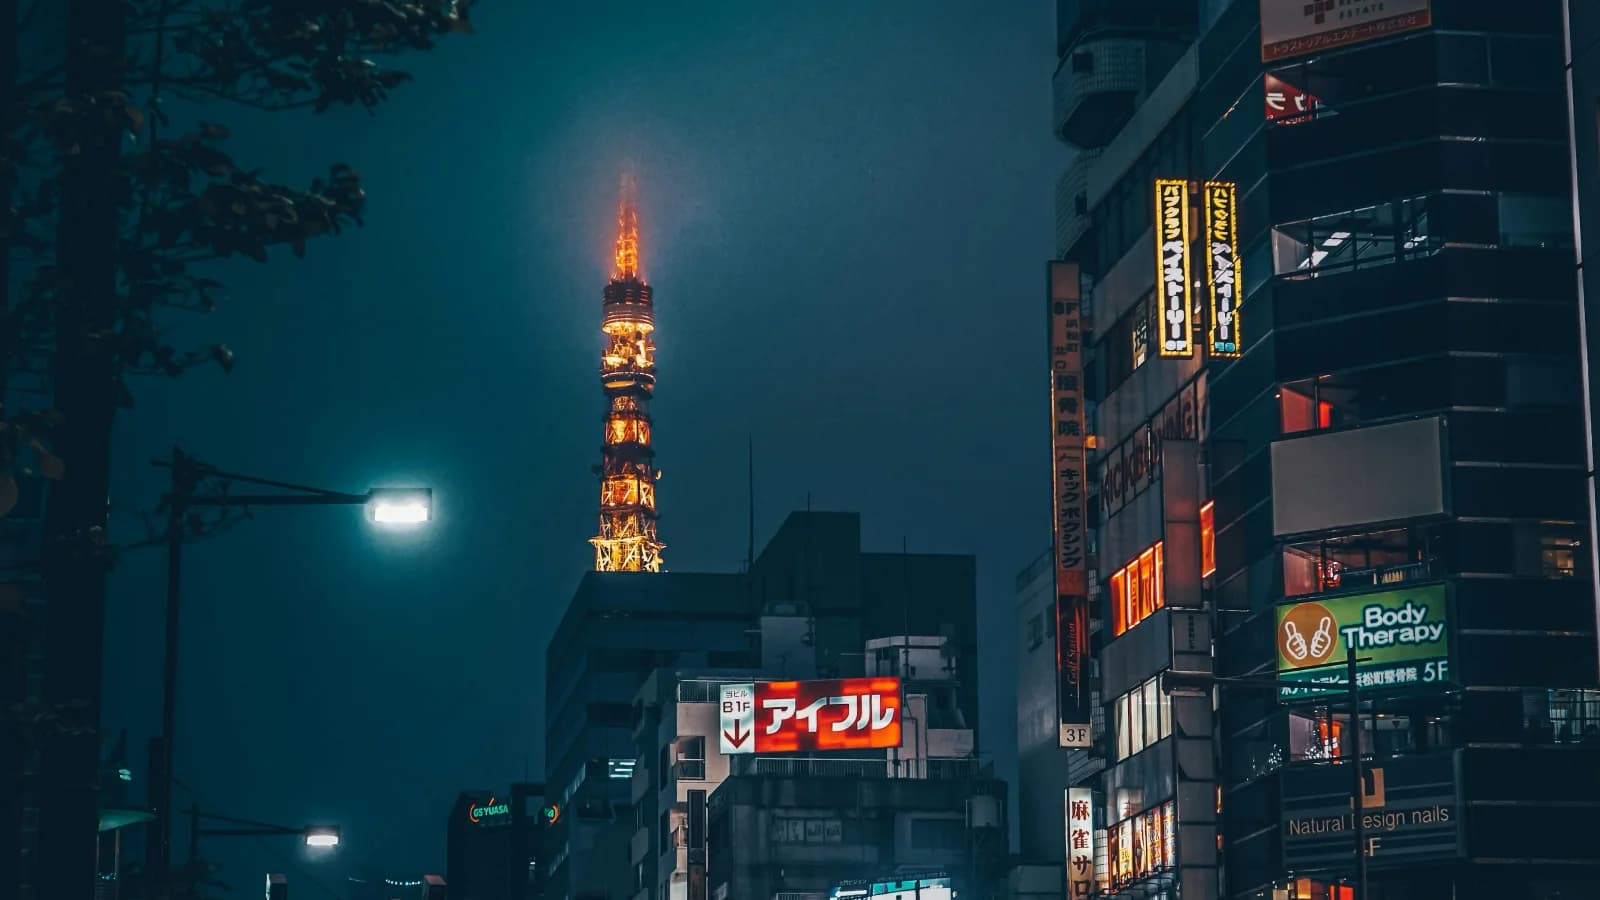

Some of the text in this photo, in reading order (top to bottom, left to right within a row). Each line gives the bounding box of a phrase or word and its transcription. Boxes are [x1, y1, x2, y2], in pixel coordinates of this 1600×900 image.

[1364, 603, 1427, 628] Body
[1341, 623, 1444, 649] Therapy
[1422, 660, 1448, 682] 5F
[722, 700, 751, 713] B1F
[762, 694, 895, 735] アイフル
[1066, 728, 1087, 743] 3F
[484, 804, 509, 816] YUASA
[1289, 815, 1345, 836] Natural
[1411, 804, 1449, 825] nails
